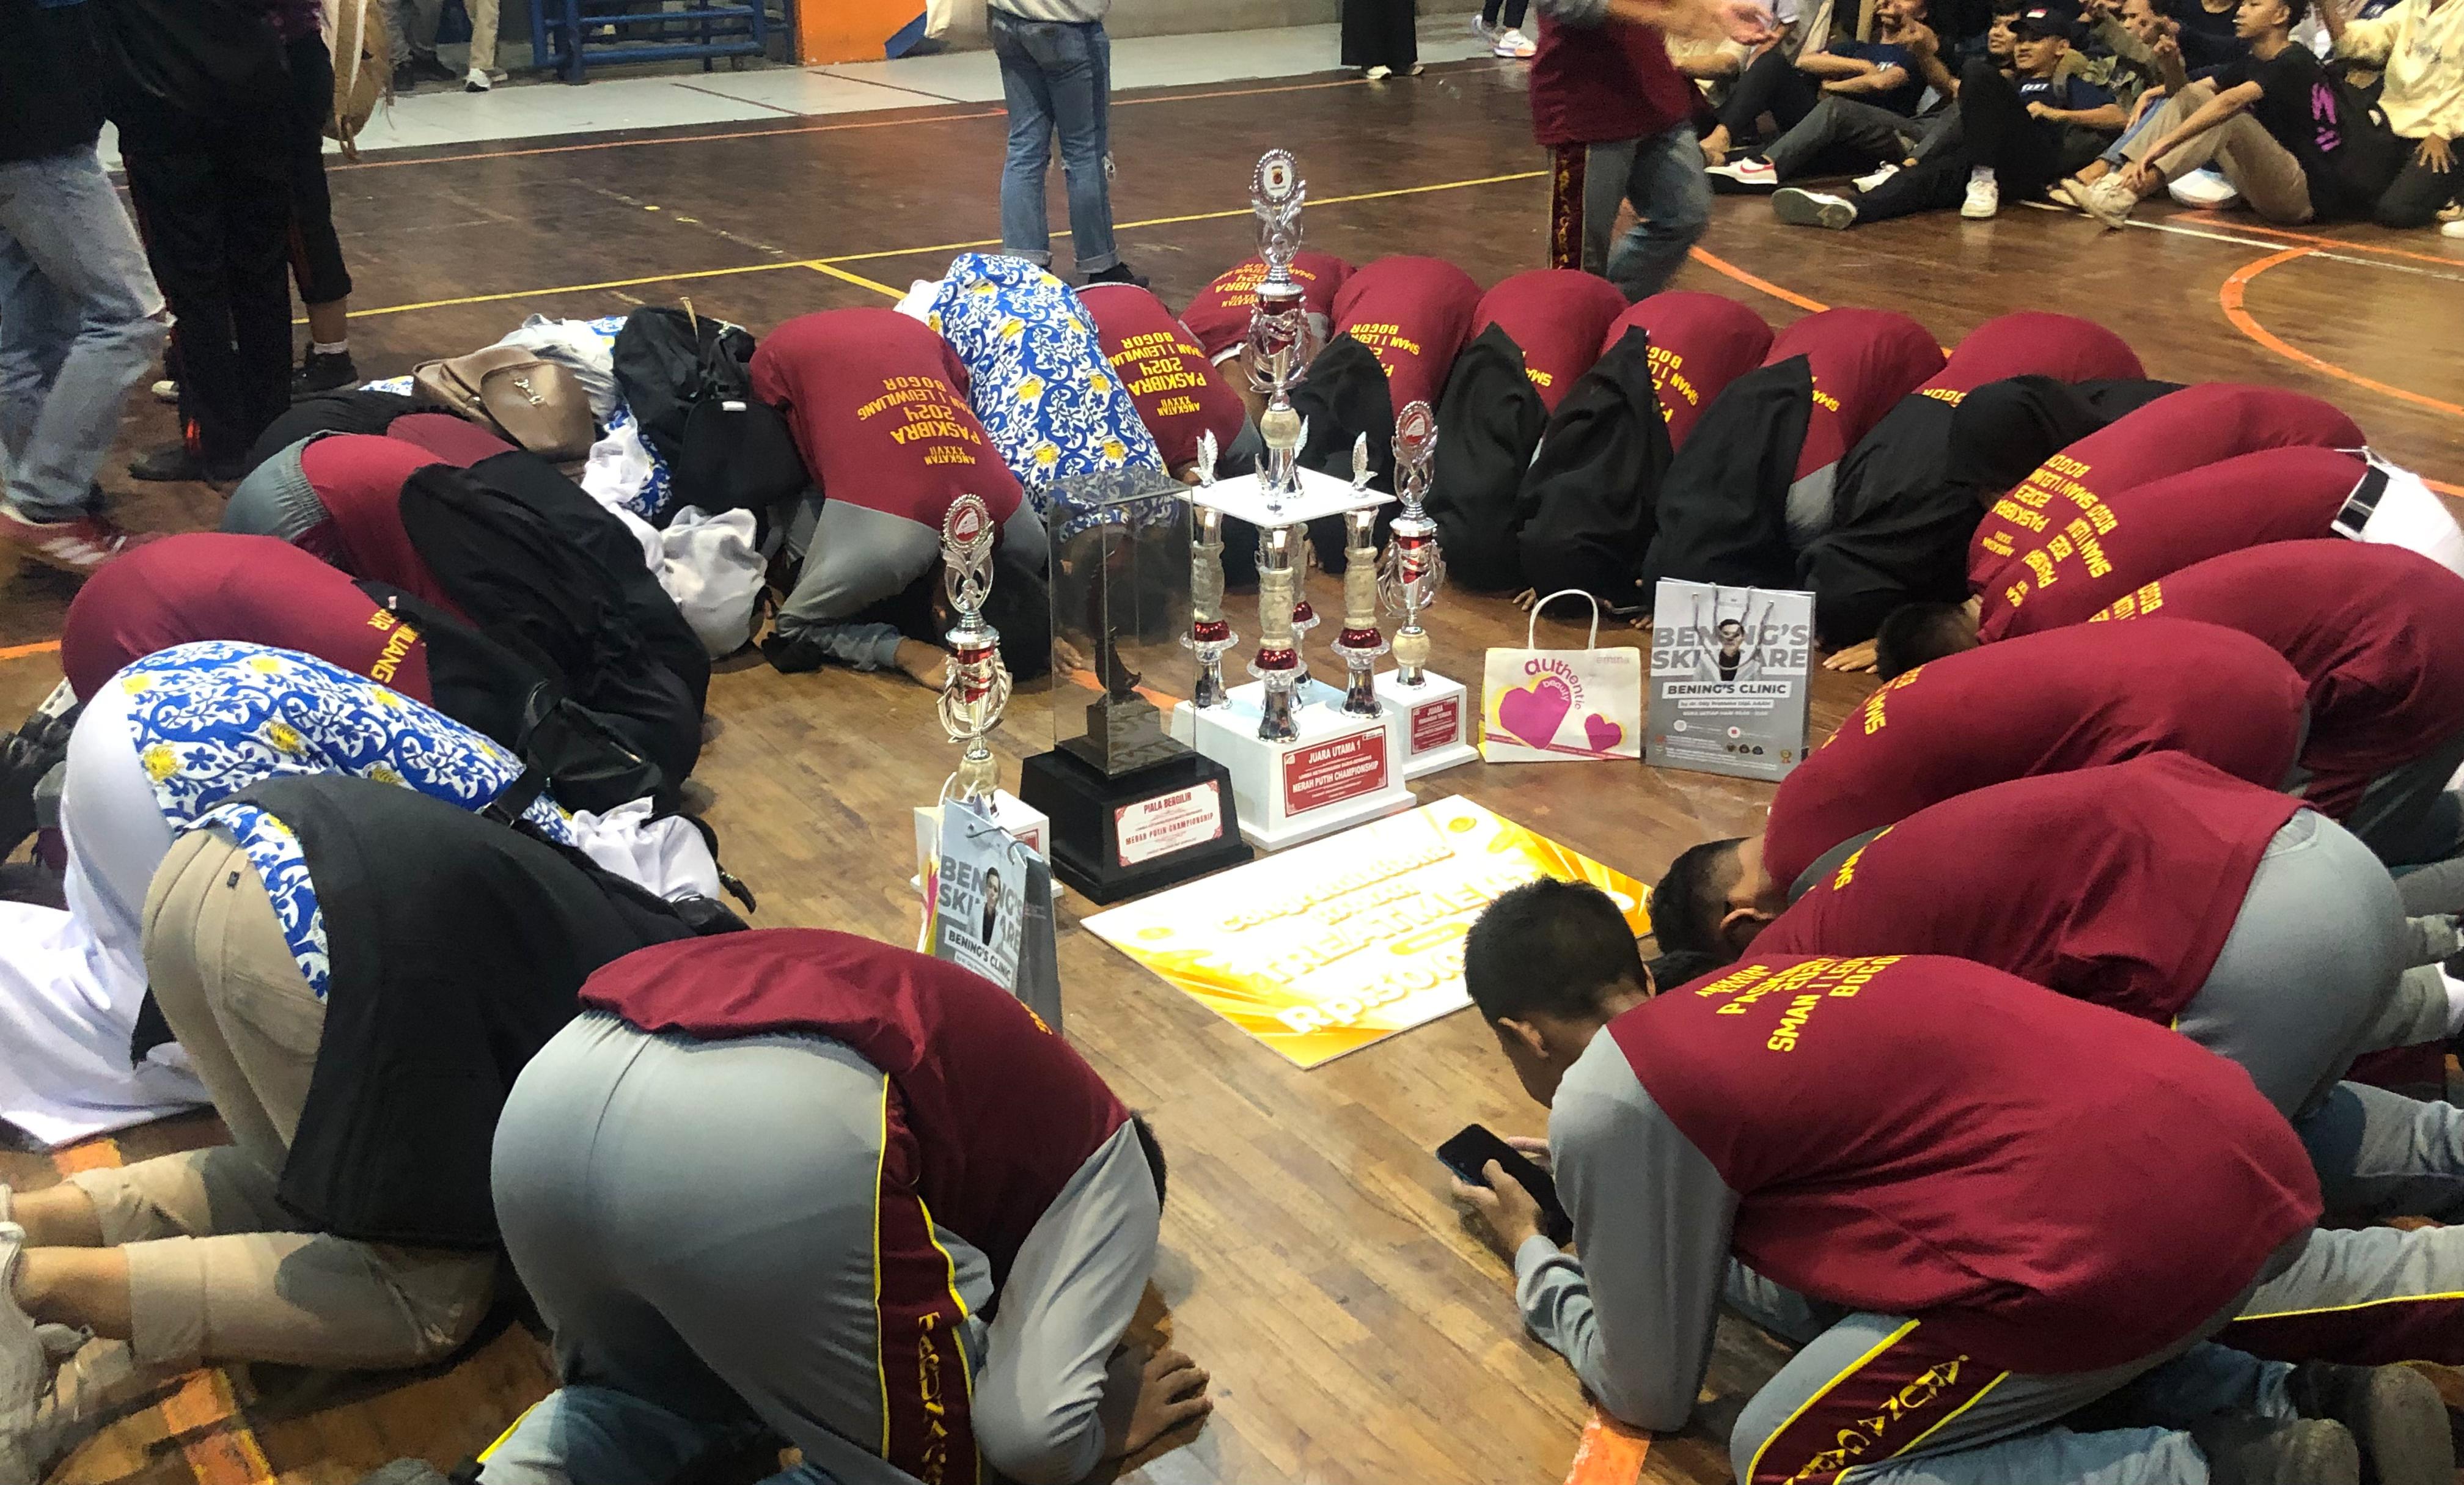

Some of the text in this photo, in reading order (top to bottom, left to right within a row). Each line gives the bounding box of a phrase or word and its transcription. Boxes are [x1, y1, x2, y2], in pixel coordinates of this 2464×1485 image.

[1120, 332, 1175, 349] BOGOR
[1350, 323, 1399, 335] BOGOR
[1390, 336, 1420, 356] SMAN
[1138, 357, 1183, 376] 2024
[882, 376, 947, 392] BOGOR
[1127, 372, 1207, 396] PASKIBRA
[857, 389, 936, 421] LEUWILIANG
[903, 404, 956, 422] 2024
[1157, 402, 1200, 416] ANGKATAN
[890, 420, 982, 446] PASKIBRA
[923, 455, 976, 466] ANGKATAN
[2014, 485, 2053, 508] 2023
[2078, 537, 2112, 578] SMAN
[1524, 658, 1585, 710] authentic
[1542, 679, 1569, 702] beauty
[1668, 684, 1786, 695] BENING'S CLINIC
[1308, 739, 1362, 765] JUARA UTAMA 1
[1292, 779, 1314, 793] MERAH
[1314, 773, 1333, 787] PUTIH
[1334, 760, 1379, 781] CHAMPIONSHIP
[1144, 791, 1192, 815] PIALA BERGILIR
[1125, 832, 1147, 845] MERAH
[1149, 826, 1167, 838] PUTIH
[1169, 812, 1214, 832] CHAMPIONSHIP
[948, 930, 989, 964] BENING'S
[989, 955, 1011, 981] CLINIC
[1767, 994, 1822, 1052] SMAN
